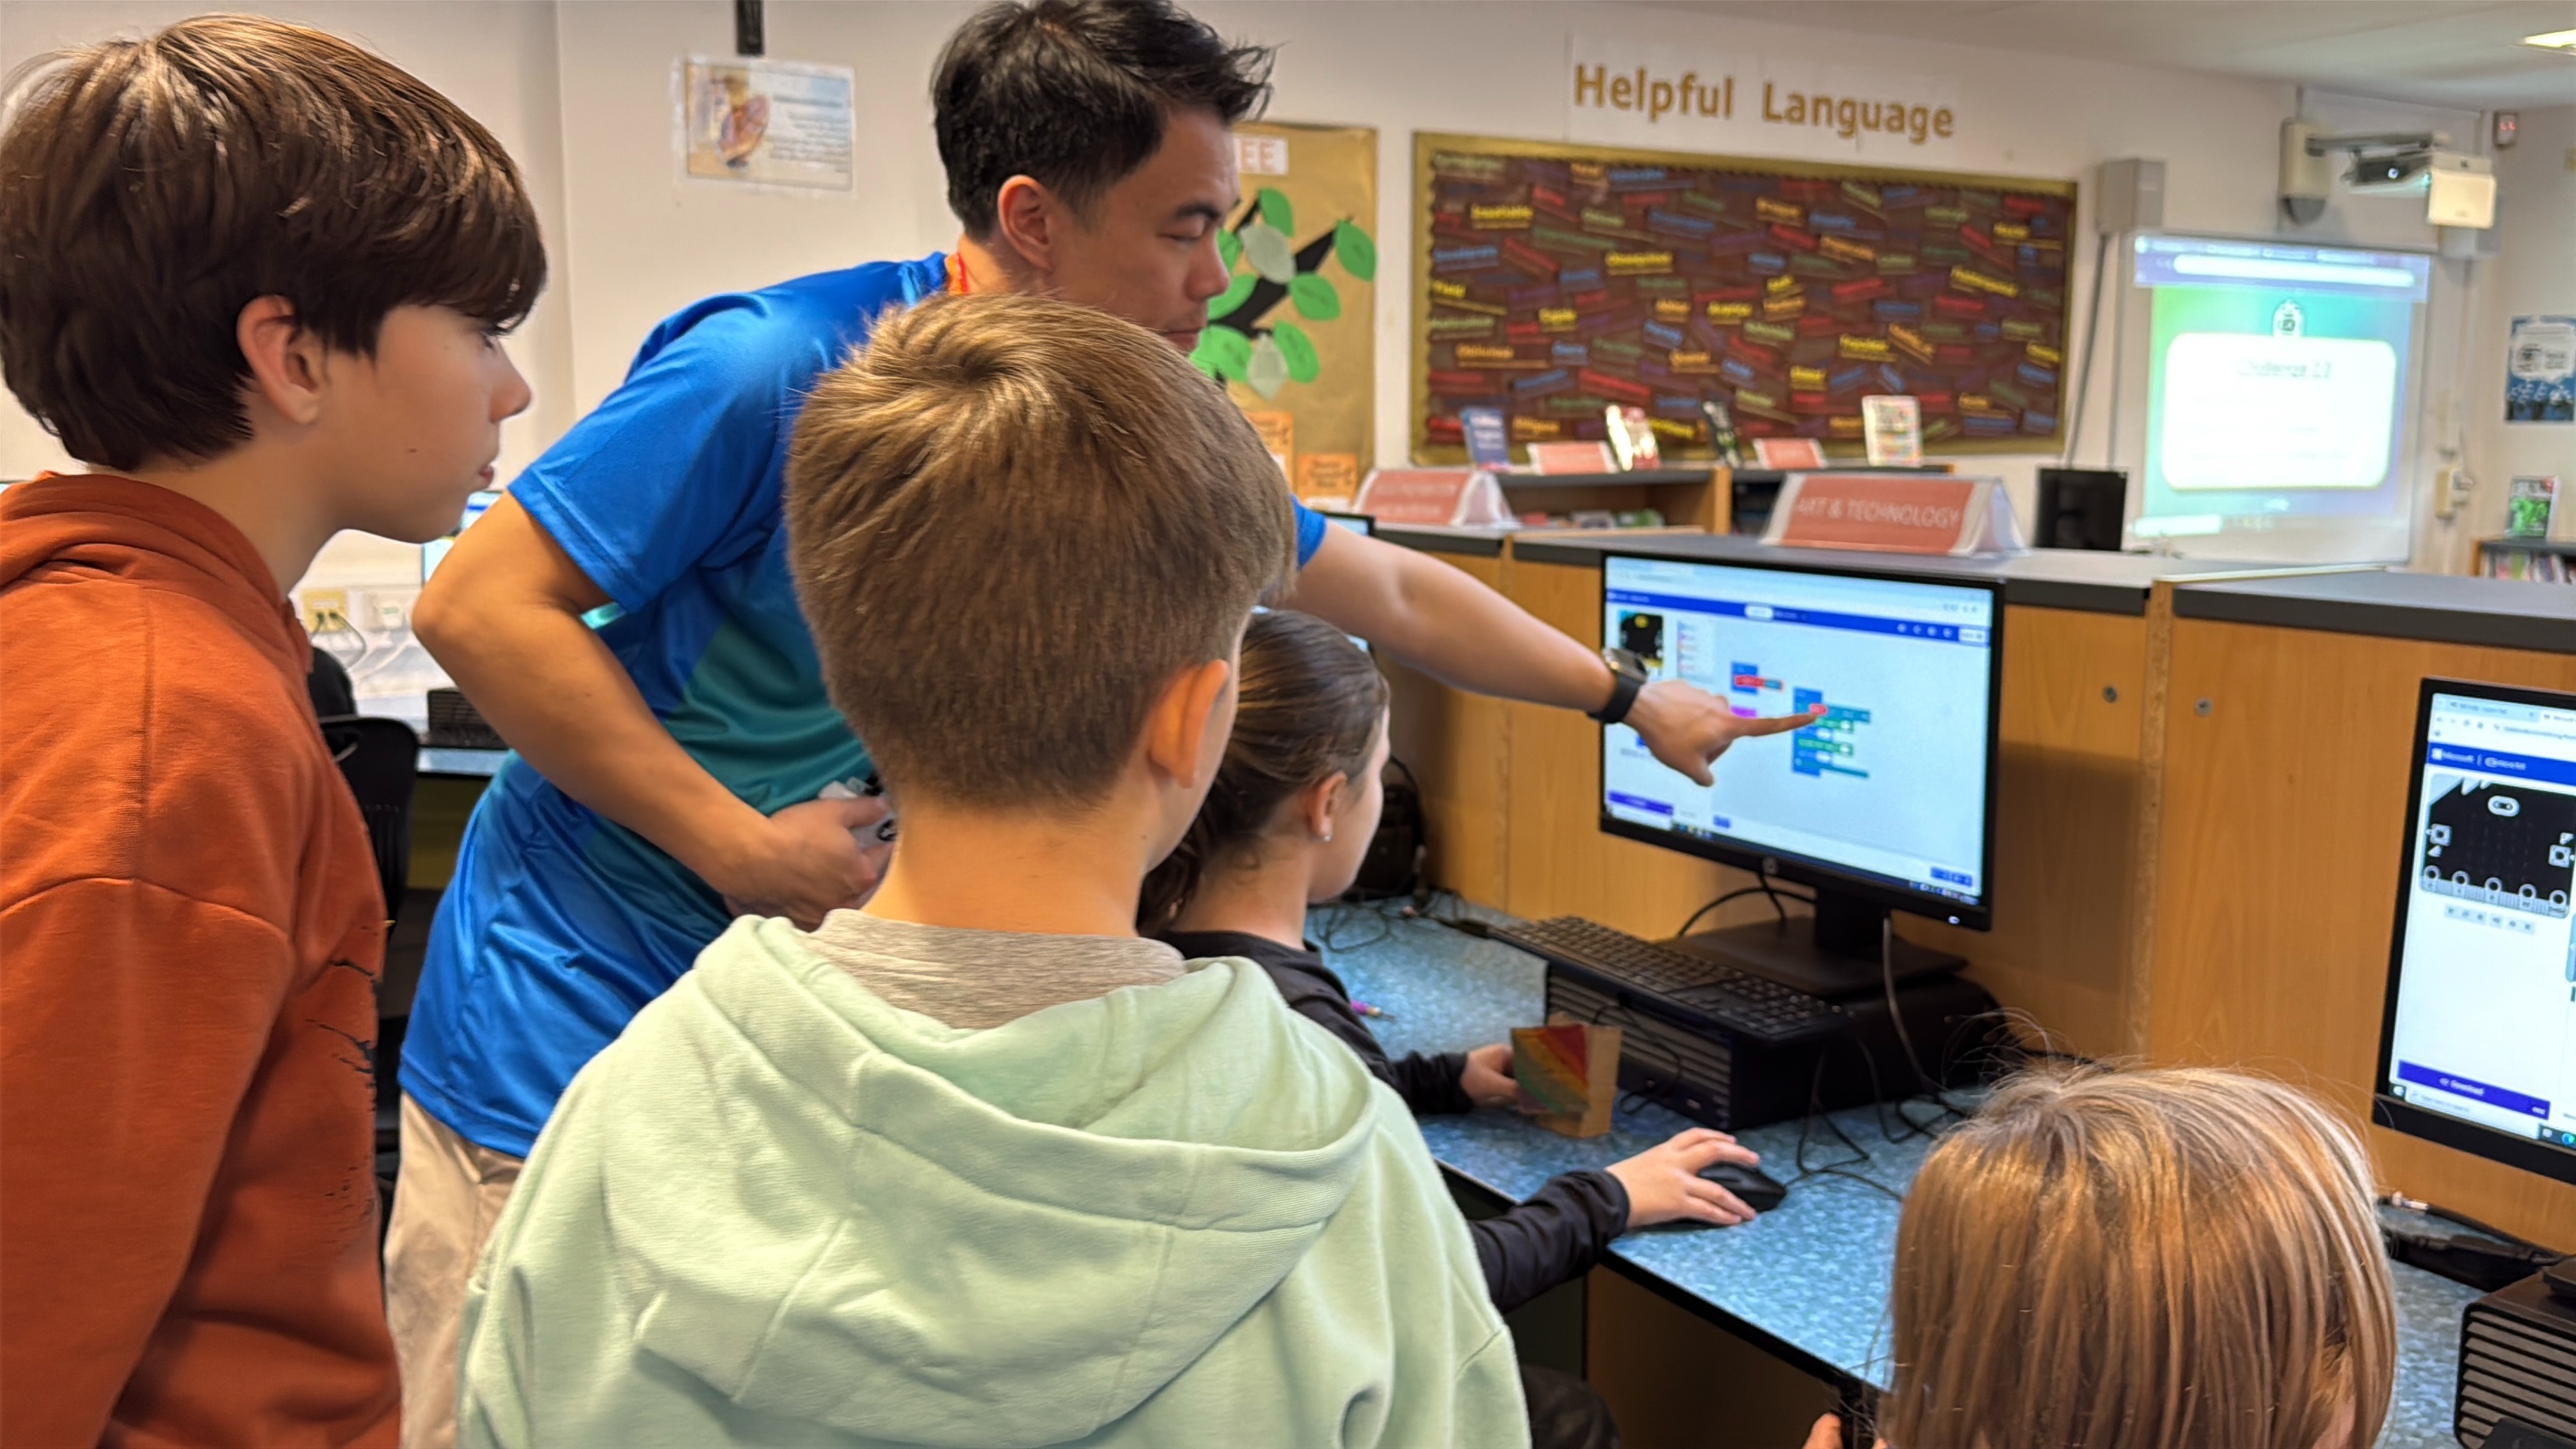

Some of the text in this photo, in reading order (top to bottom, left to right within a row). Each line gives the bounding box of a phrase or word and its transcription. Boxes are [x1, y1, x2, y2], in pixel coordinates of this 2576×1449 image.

[1574, 63, 1954, 144] Helpful Language
[1797, 497, 1960, 529] ART & TECHNOLOGY
